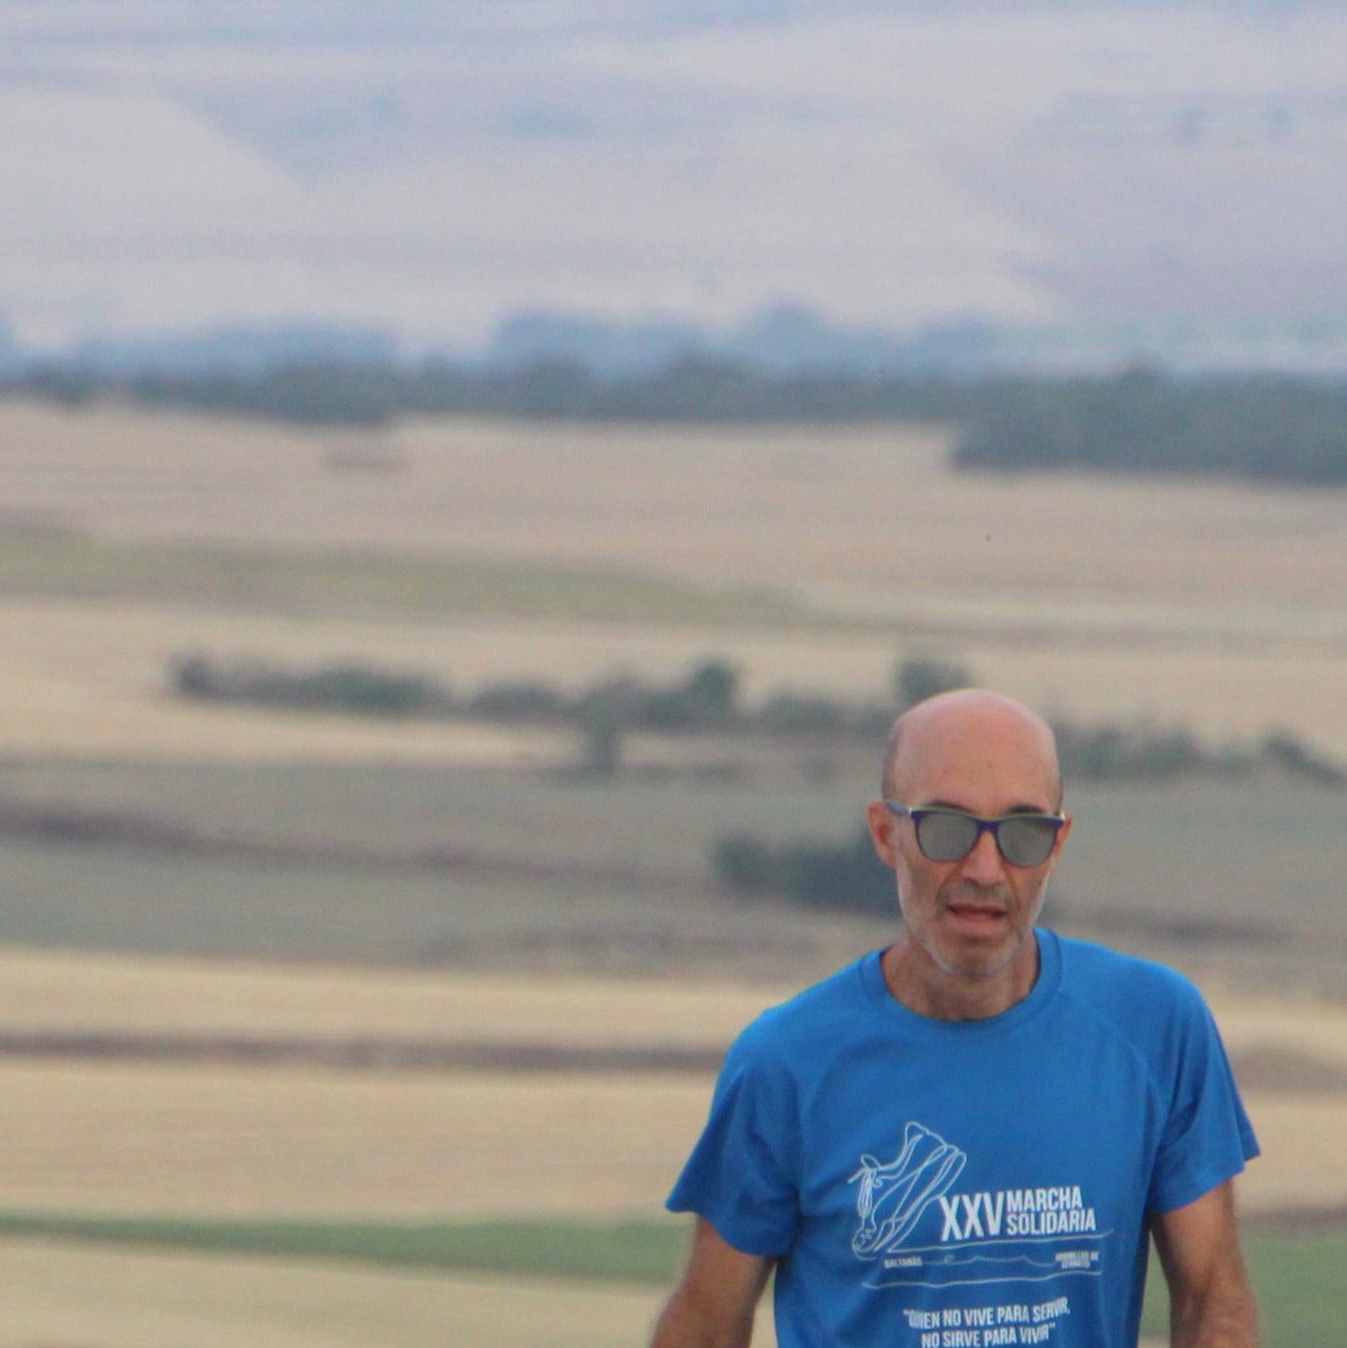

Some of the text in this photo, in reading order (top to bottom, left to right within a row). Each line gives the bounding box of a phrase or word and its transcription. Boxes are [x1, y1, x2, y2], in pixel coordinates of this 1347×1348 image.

[939, 1186, 1083, 1242] XXV MARCHA
[1006, 1207, 1097, 1236] SOLIDARIA
[943, 1308, 962, 1327] NO
[964, 1306, 995, 1327] VIVE
[997, 1303, 1030, 1324] PARA
[942, 1329, 981, 1348] SIRVE
[984, 1326, 1017, 1347] PARA
